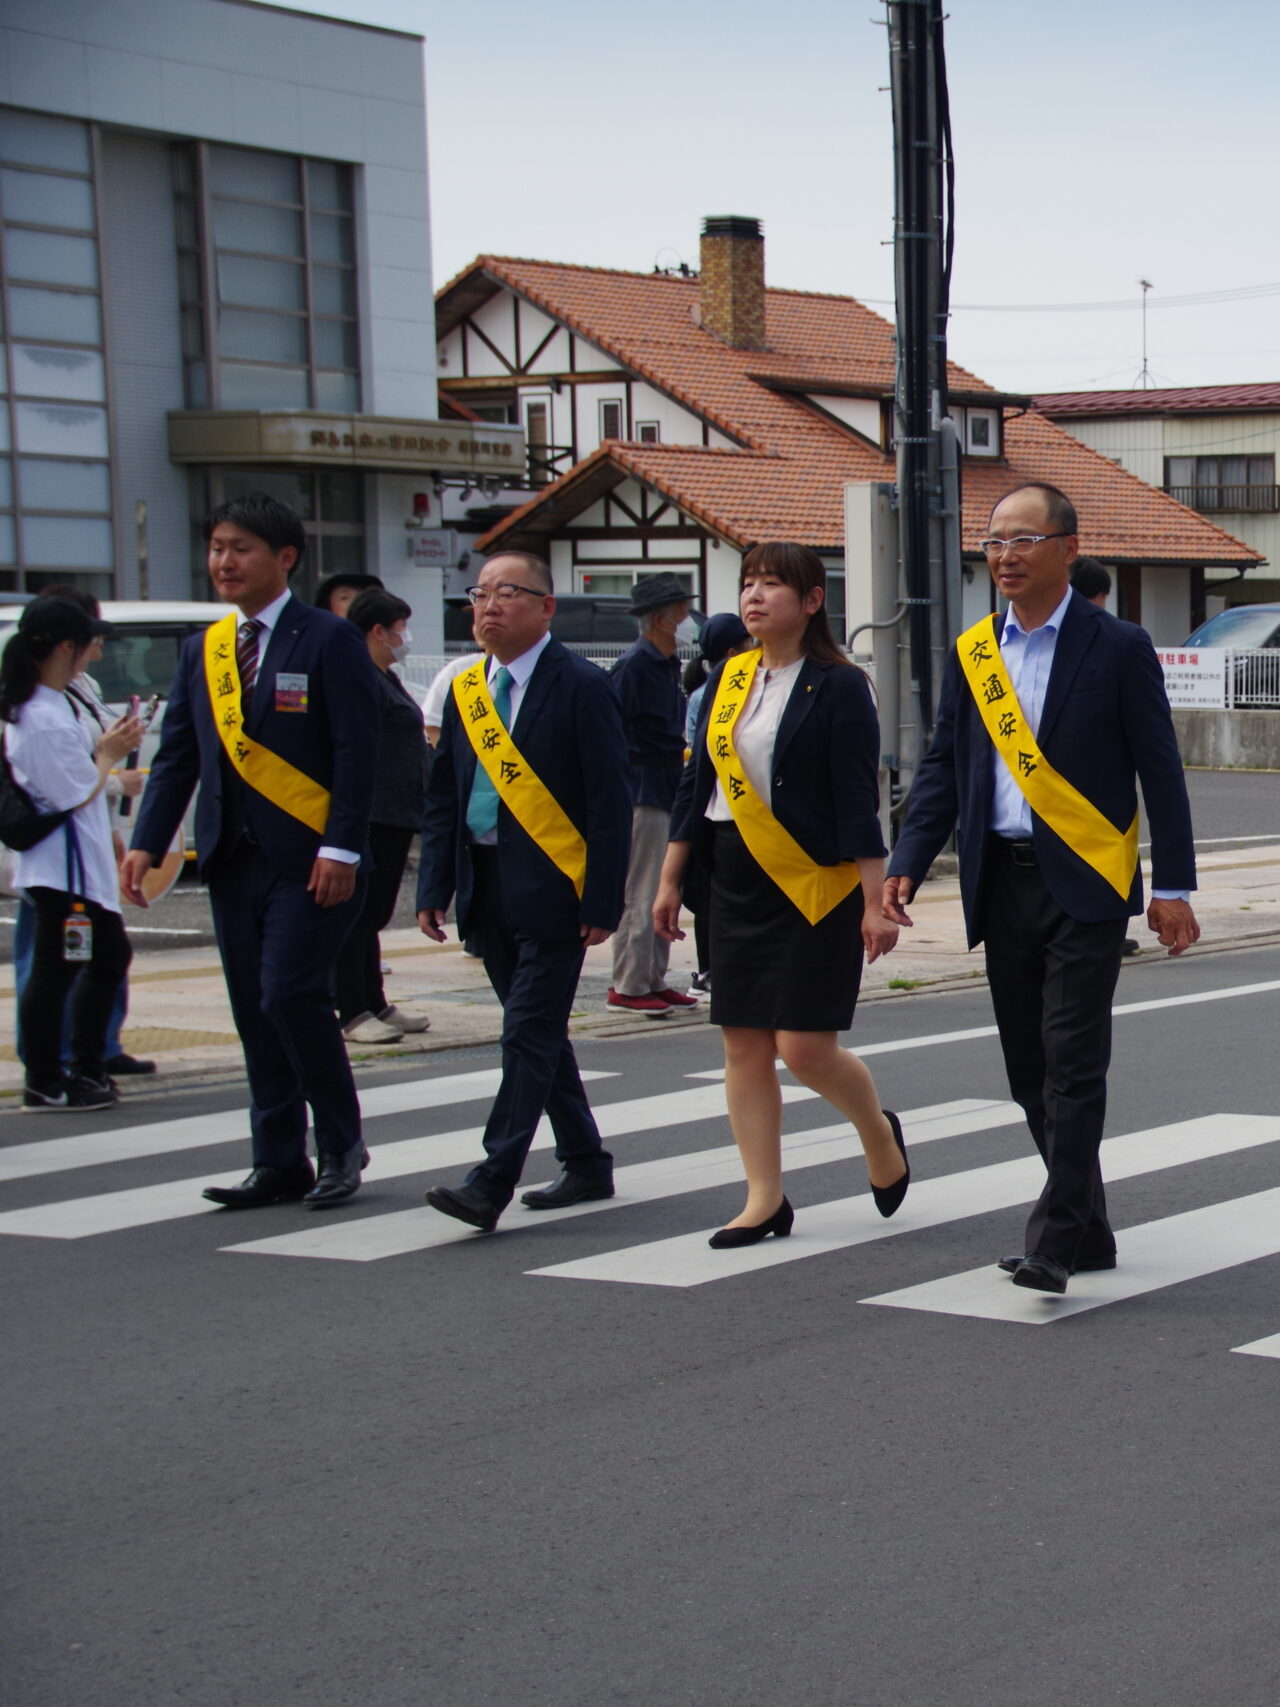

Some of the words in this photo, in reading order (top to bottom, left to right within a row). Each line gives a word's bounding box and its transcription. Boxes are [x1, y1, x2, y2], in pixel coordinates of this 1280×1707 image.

[213, 643, 250, 762] 交通安全
[462, 670, 522, 784] 交通安全
[715, 669, 750, 800] 交通安全
[969, 640, 1037, 777] 交通安全
